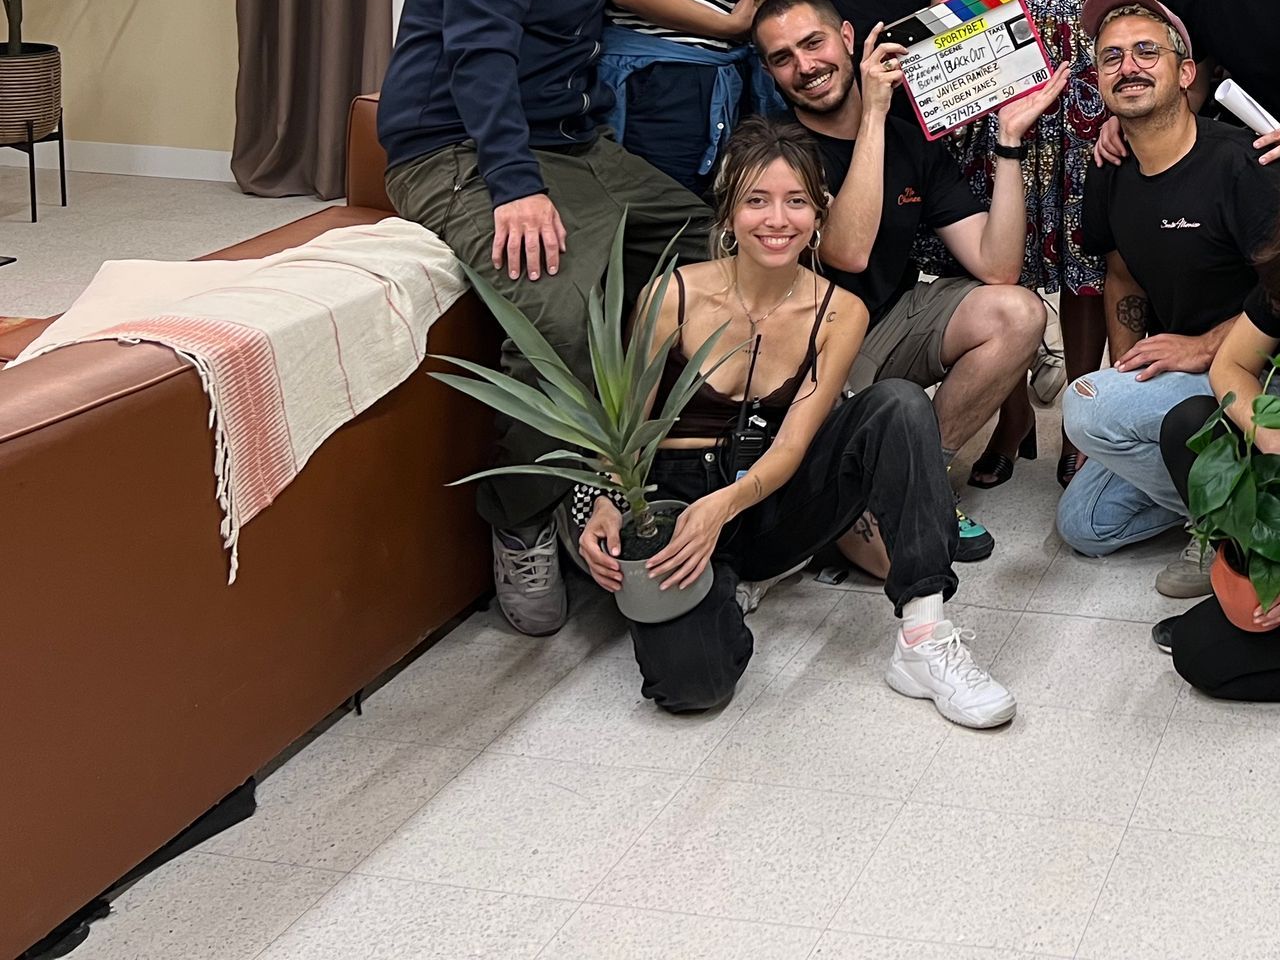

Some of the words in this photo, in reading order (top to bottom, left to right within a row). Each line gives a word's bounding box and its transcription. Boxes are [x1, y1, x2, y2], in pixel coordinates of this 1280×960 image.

[934, 17, 985, 49] SPORTYBET
[988, 24, 1006, 36] TAKE
[939, 43, 964, 59] SCENE
[995, 34, 1011, 54] 2
[903, 63, 923, 75] ROLL
[1032, 68, 1049, 85] 180
[936, 78, 967, 99] JAVIER
[941, 90, 972, 110] RUBEN
[972, 77, 997, 94] YANES
[1002, 85, 1015, 99] 50
